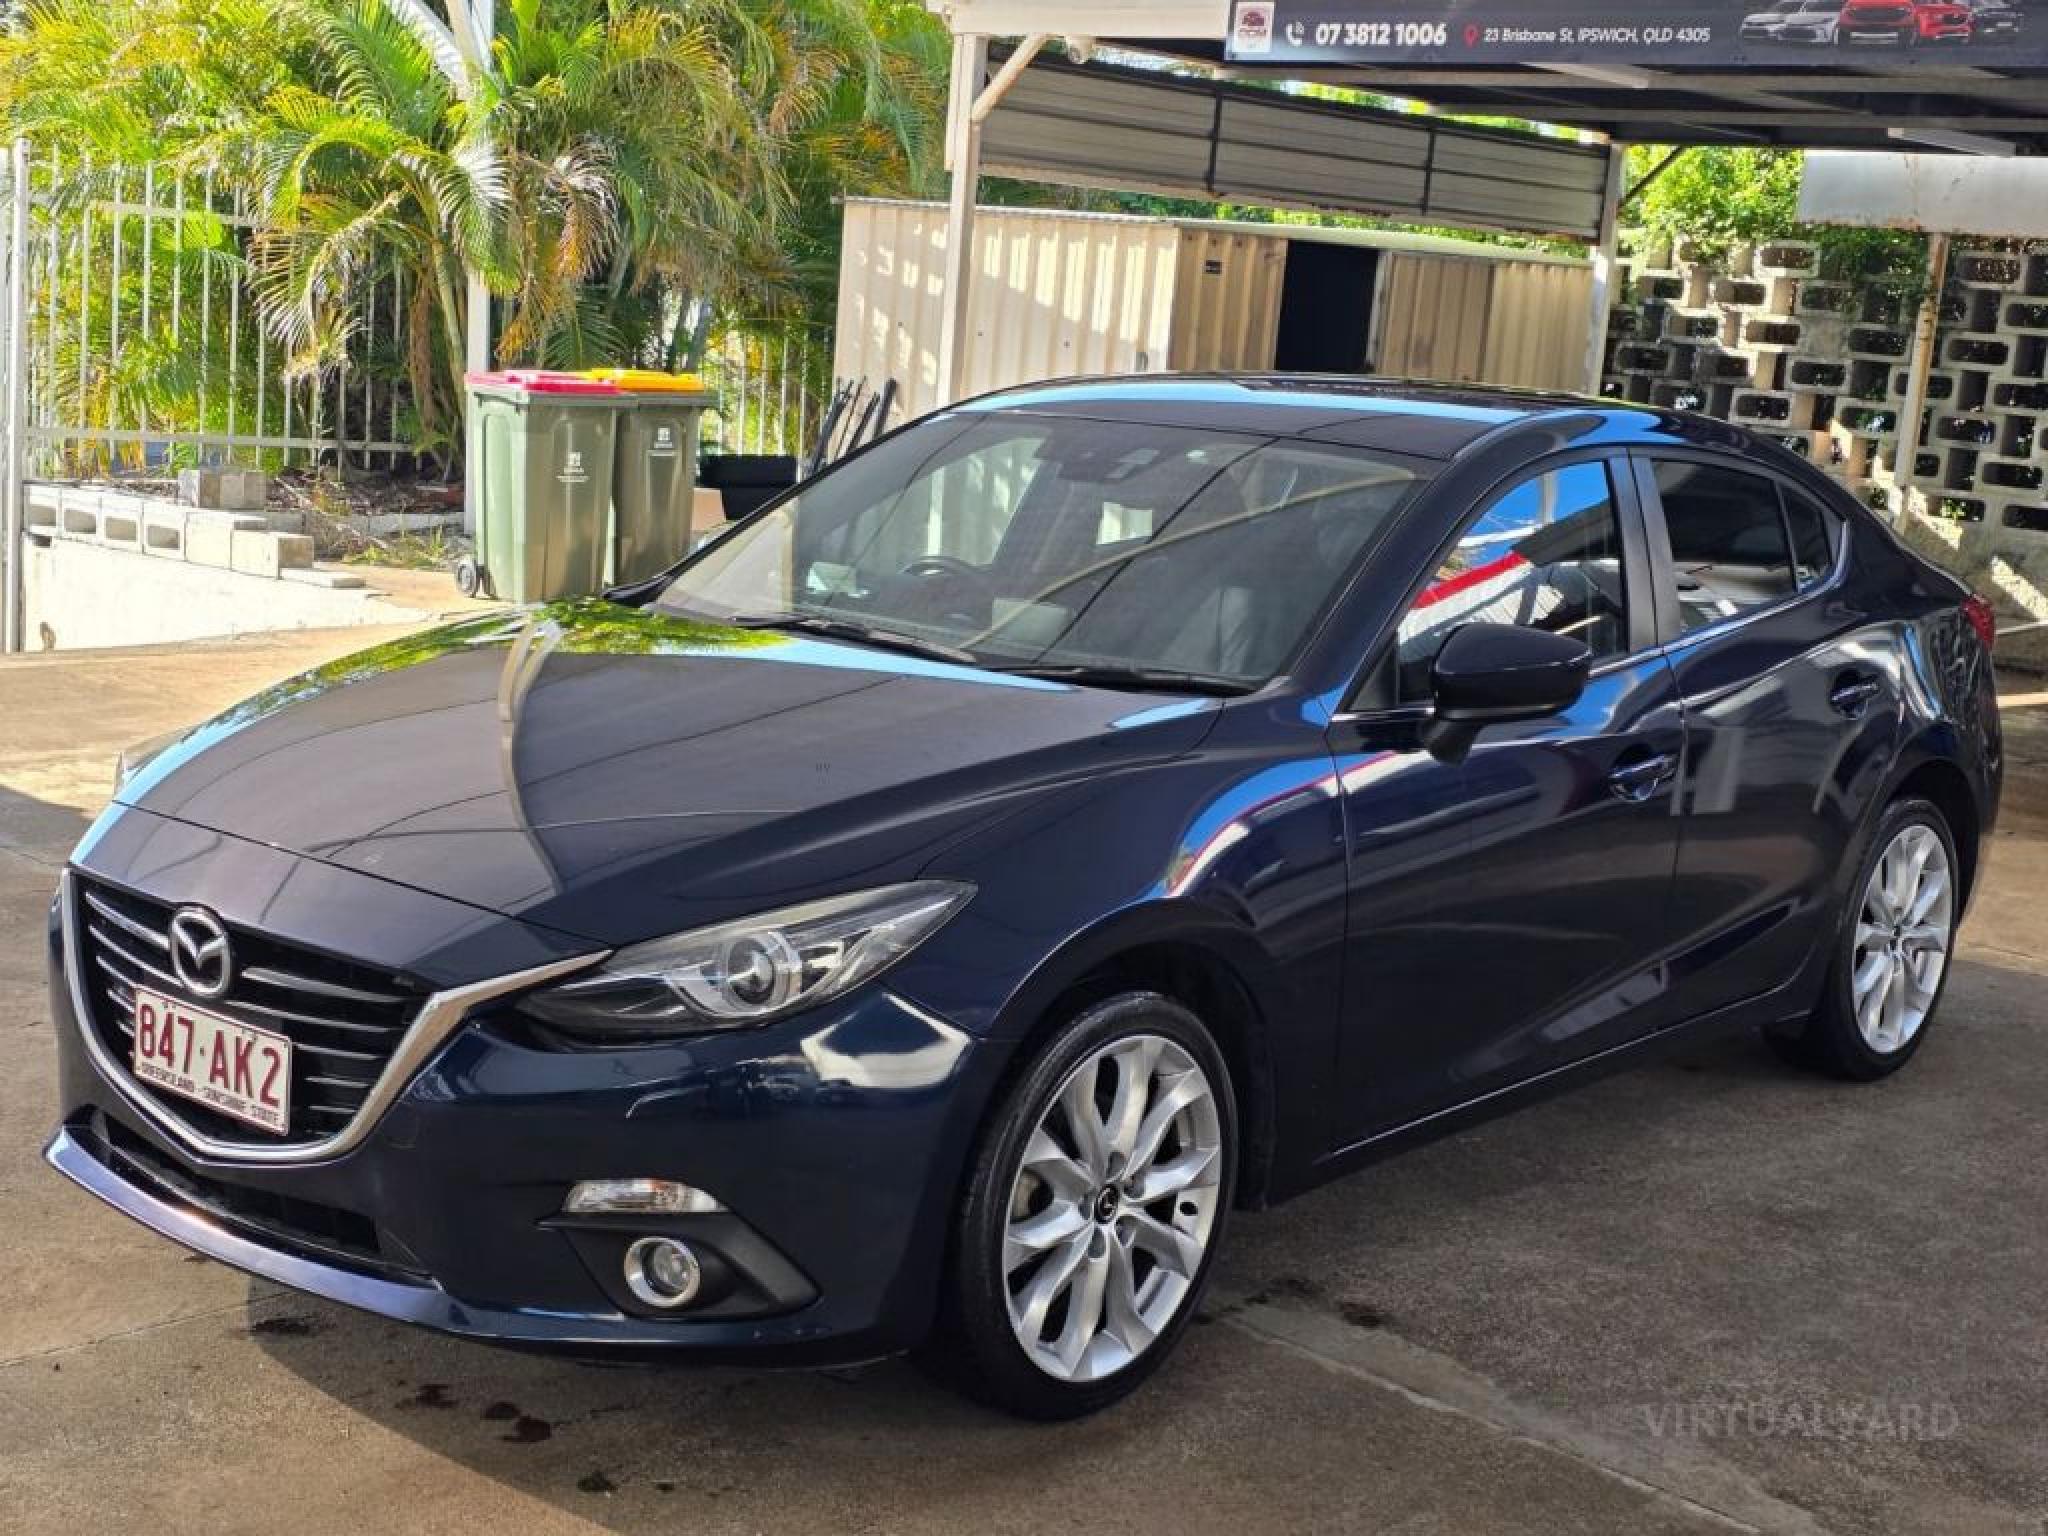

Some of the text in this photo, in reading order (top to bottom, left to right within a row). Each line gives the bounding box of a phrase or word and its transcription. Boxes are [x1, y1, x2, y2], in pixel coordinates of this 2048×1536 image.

[1316, 22, 1447, 45] 07 3812 1006
[1484, 27, 1499, 42] 23
[1502, 27, 1556, 42] Brisbane
[1643, 27, 1673, 45] QLD
[1675, 27, 1711, 42] 4305
